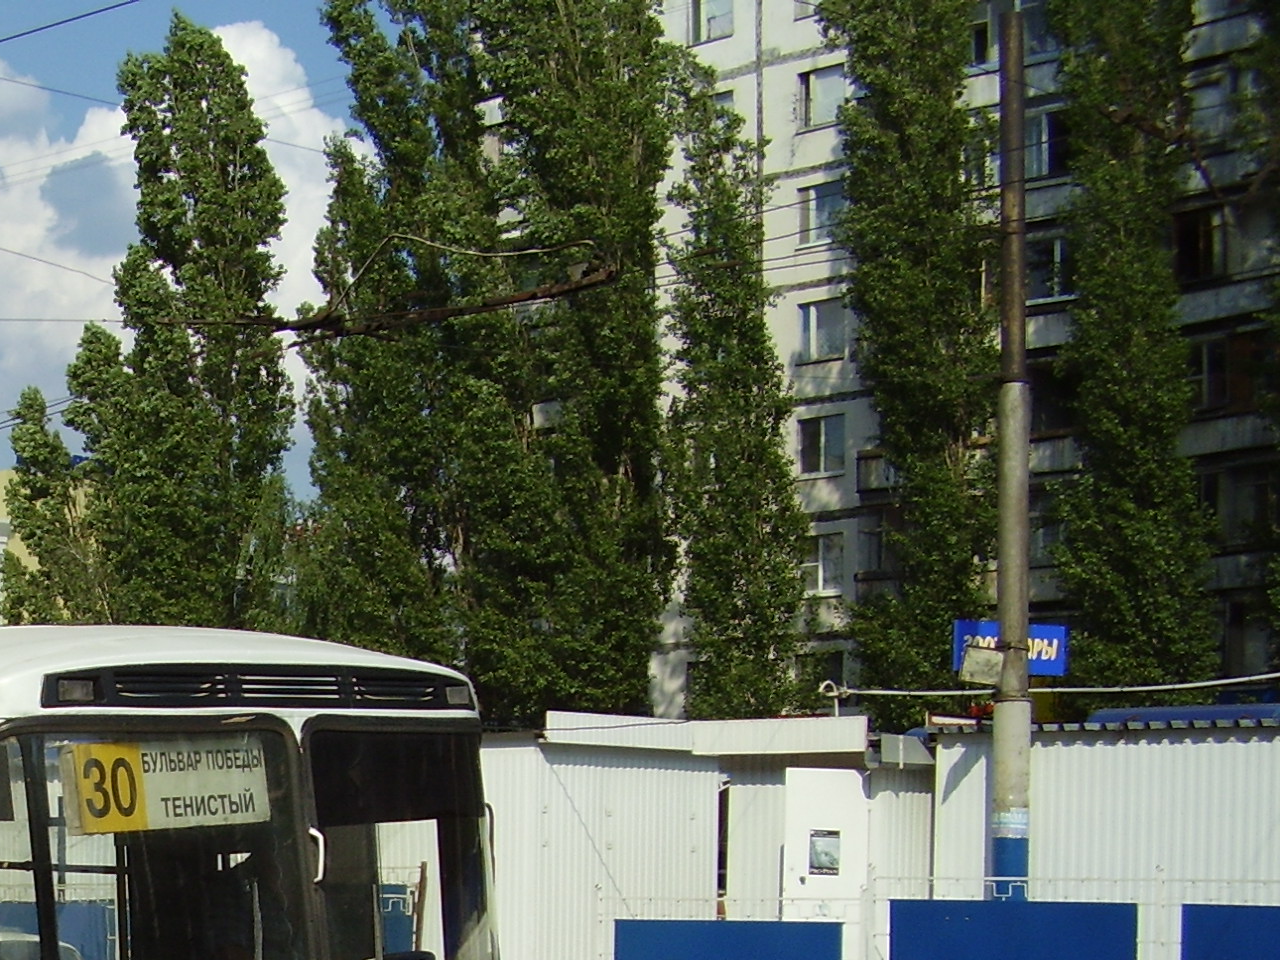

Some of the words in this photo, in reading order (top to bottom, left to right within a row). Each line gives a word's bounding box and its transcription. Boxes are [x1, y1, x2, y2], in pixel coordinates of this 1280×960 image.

[83, 757, 137, 818] 30
[141, 751, 202, 774] БУЛЬВАР
[206, 749, 263, 773] ПОБЕДЫ
[160, 787, 256, 819] ТЕНИСТЫЙ
